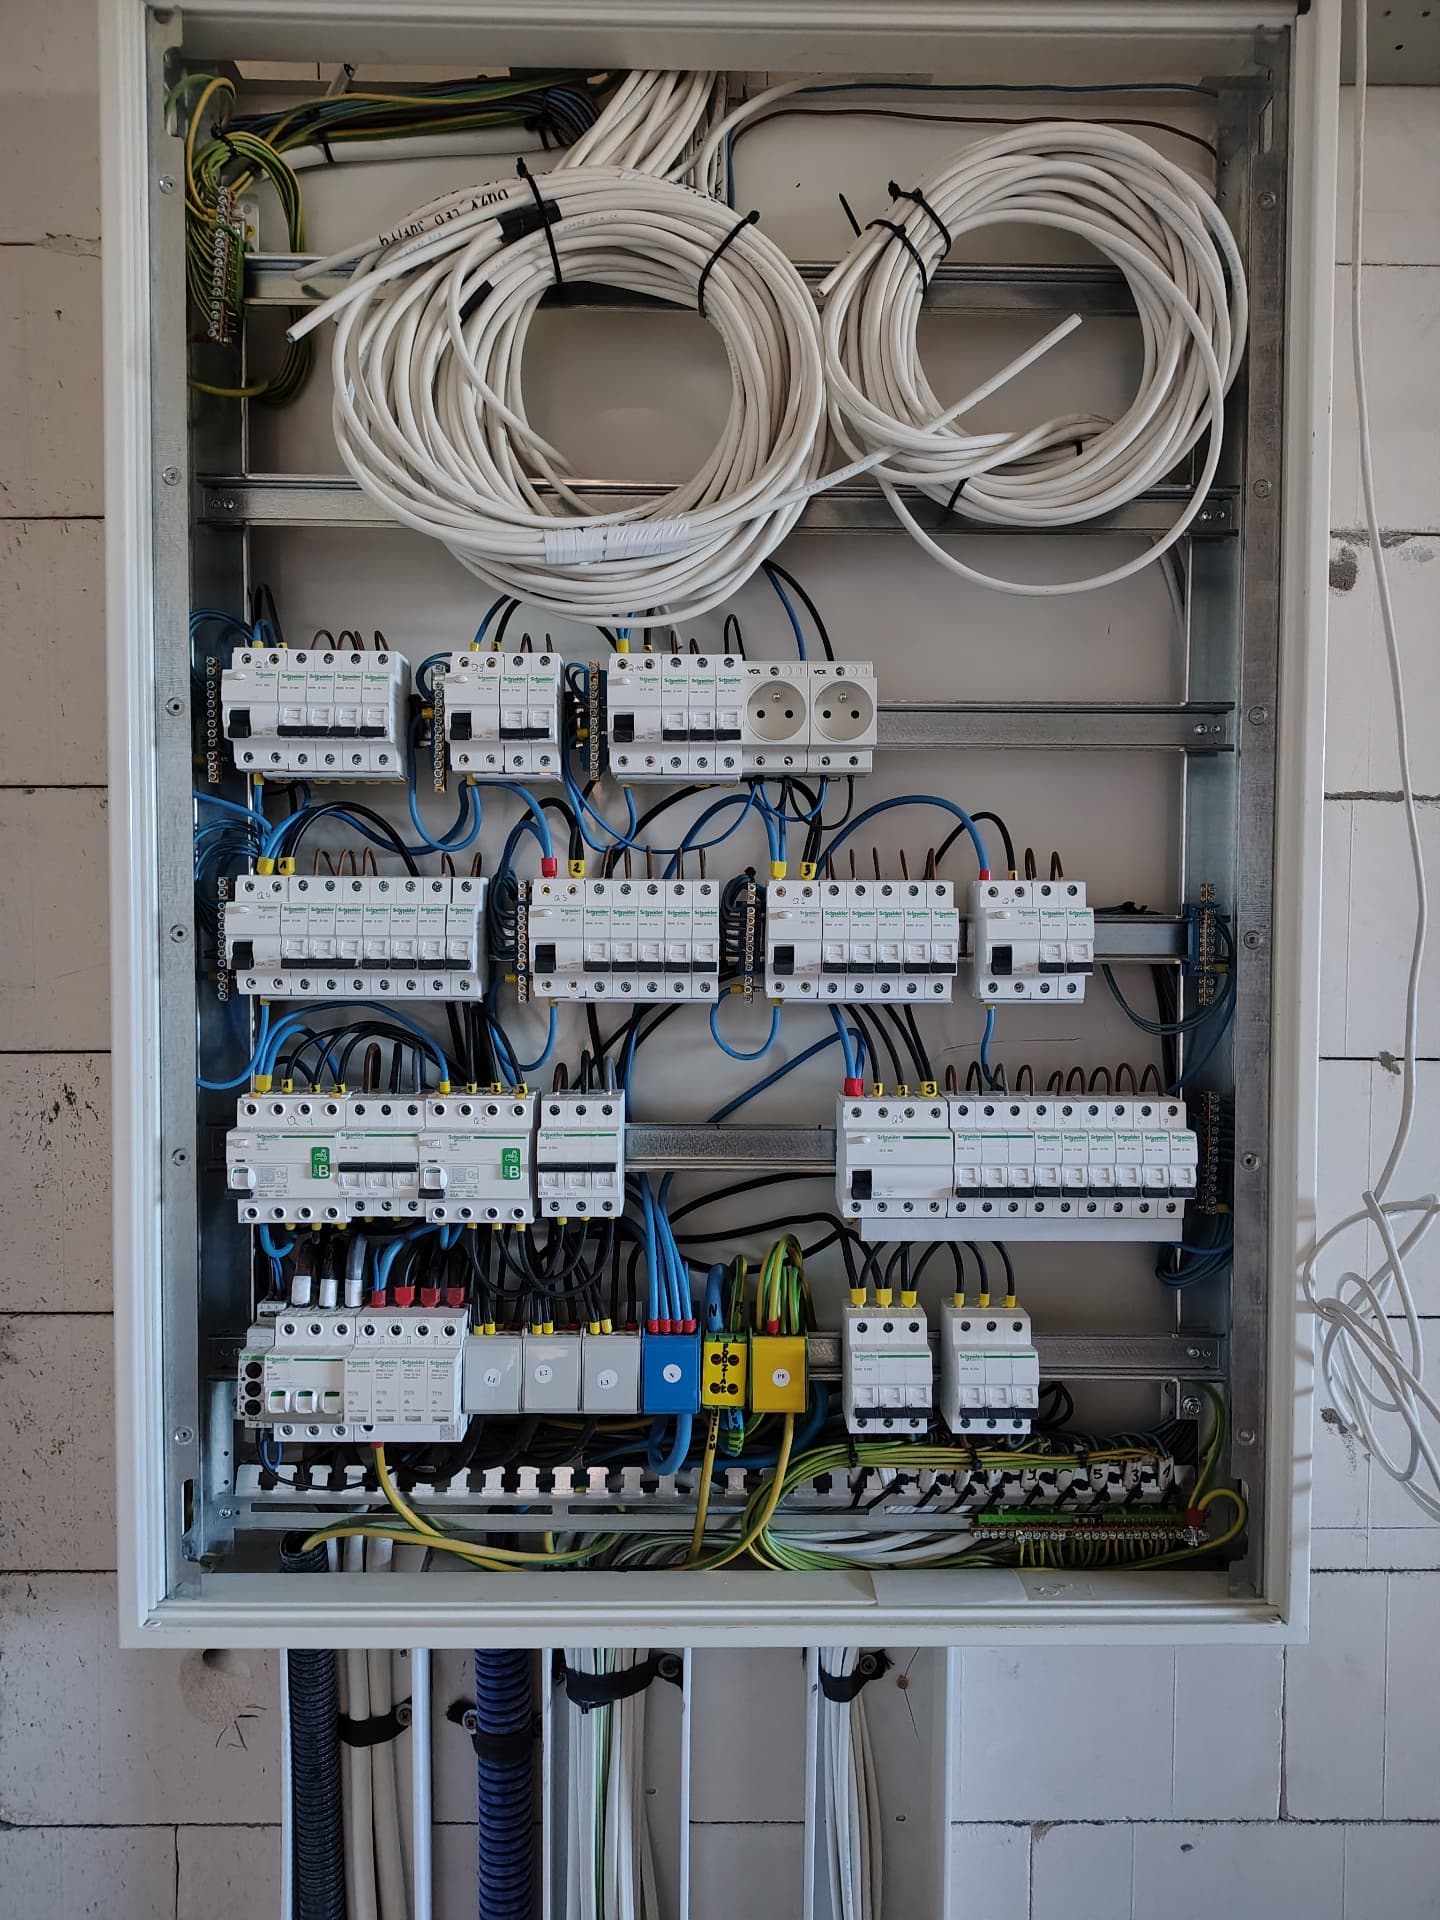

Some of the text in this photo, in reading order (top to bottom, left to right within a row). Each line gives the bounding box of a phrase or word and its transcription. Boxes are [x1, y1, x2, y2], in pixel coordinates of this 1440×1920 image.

[434, 208, 461, 226] LED
[573, 862, 581, 873] 2
[926, 1083, 935, 1094] 3
[319, 1165, 329, 1177] B
[509, 1166, 520, 1178] B
[709, 1303, 718, 1318] N
[1093, 1469, 1103, 1479] 5
[1132, 1468, 1139, 1482] 3
